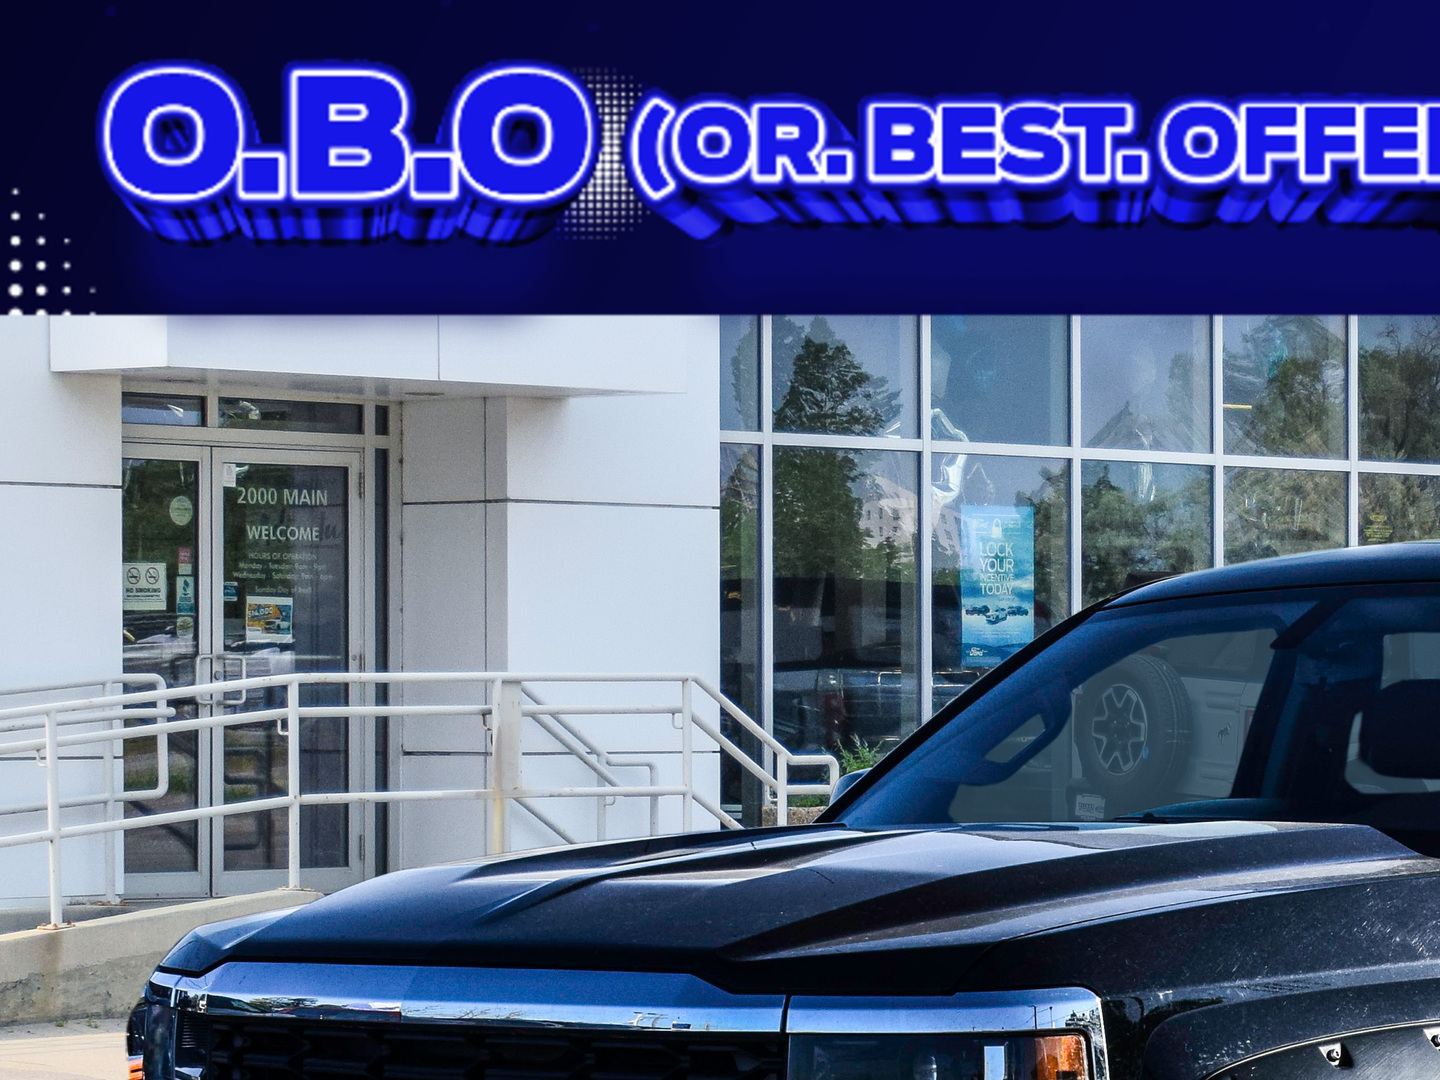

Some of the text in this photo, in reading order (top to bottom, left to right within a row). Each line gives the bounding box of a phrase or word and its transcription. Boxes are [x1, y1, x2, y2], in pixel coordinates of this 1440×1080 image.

[237, 487, 328, 506] 2000 MAIN
[246, 525, 320, 542] WELCOME
[979, 541, 1014, 556] LOCK
[979, 557, 1014, 573] YOUR
[980, 583, 1014, 595] TODAY
